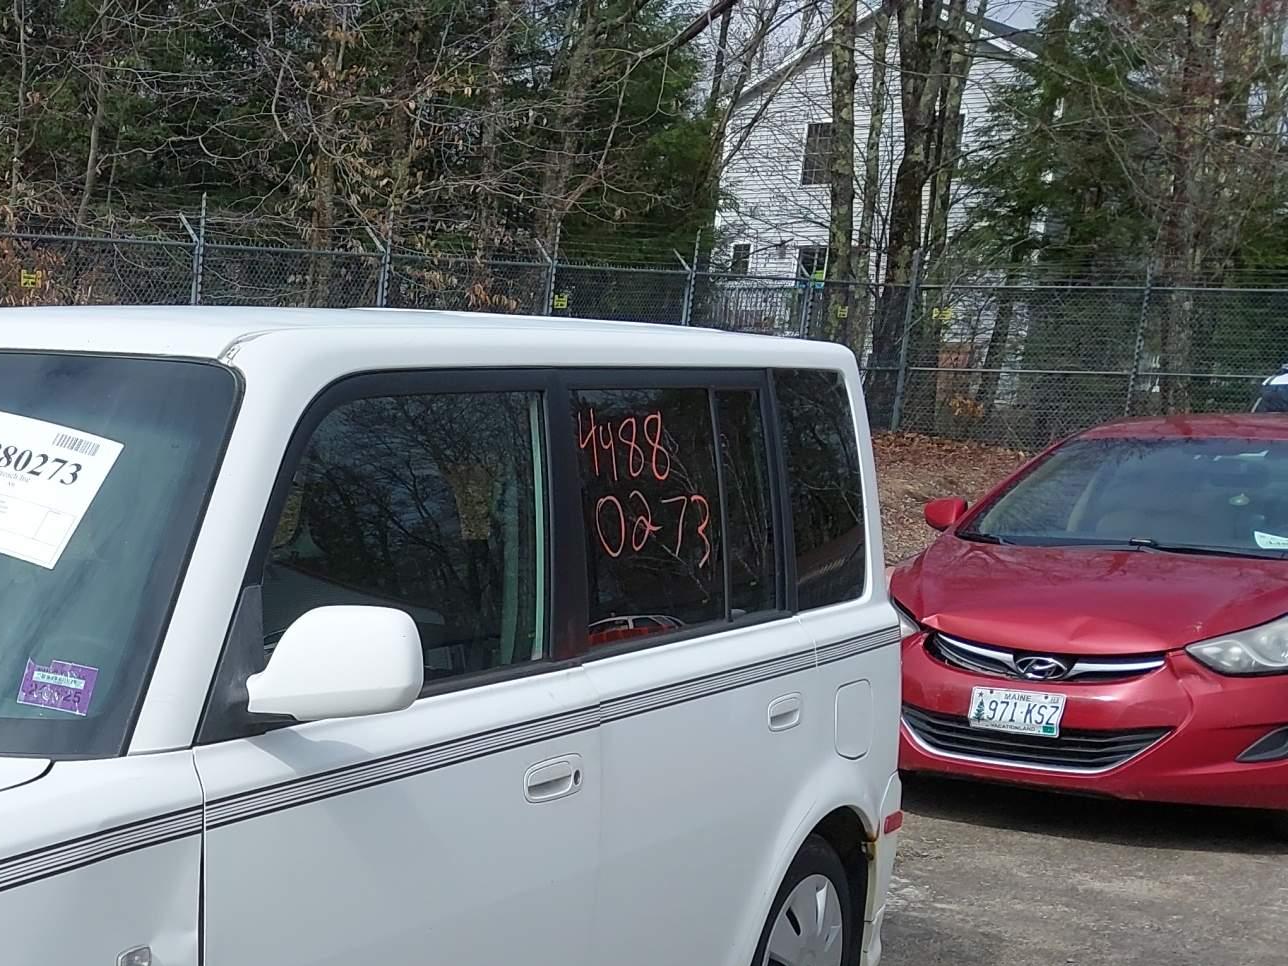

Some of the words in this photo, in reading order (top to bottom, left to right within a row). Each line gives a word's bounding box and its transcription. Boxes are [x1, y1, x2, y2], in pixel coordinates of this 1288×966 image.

[578, 408, 670, 480] 4488
[596, 490, 710, 568] 0273
[1004, 693, 1032, 701] MAINE
[991, 723, 1036, 732] VACATIONLAND
